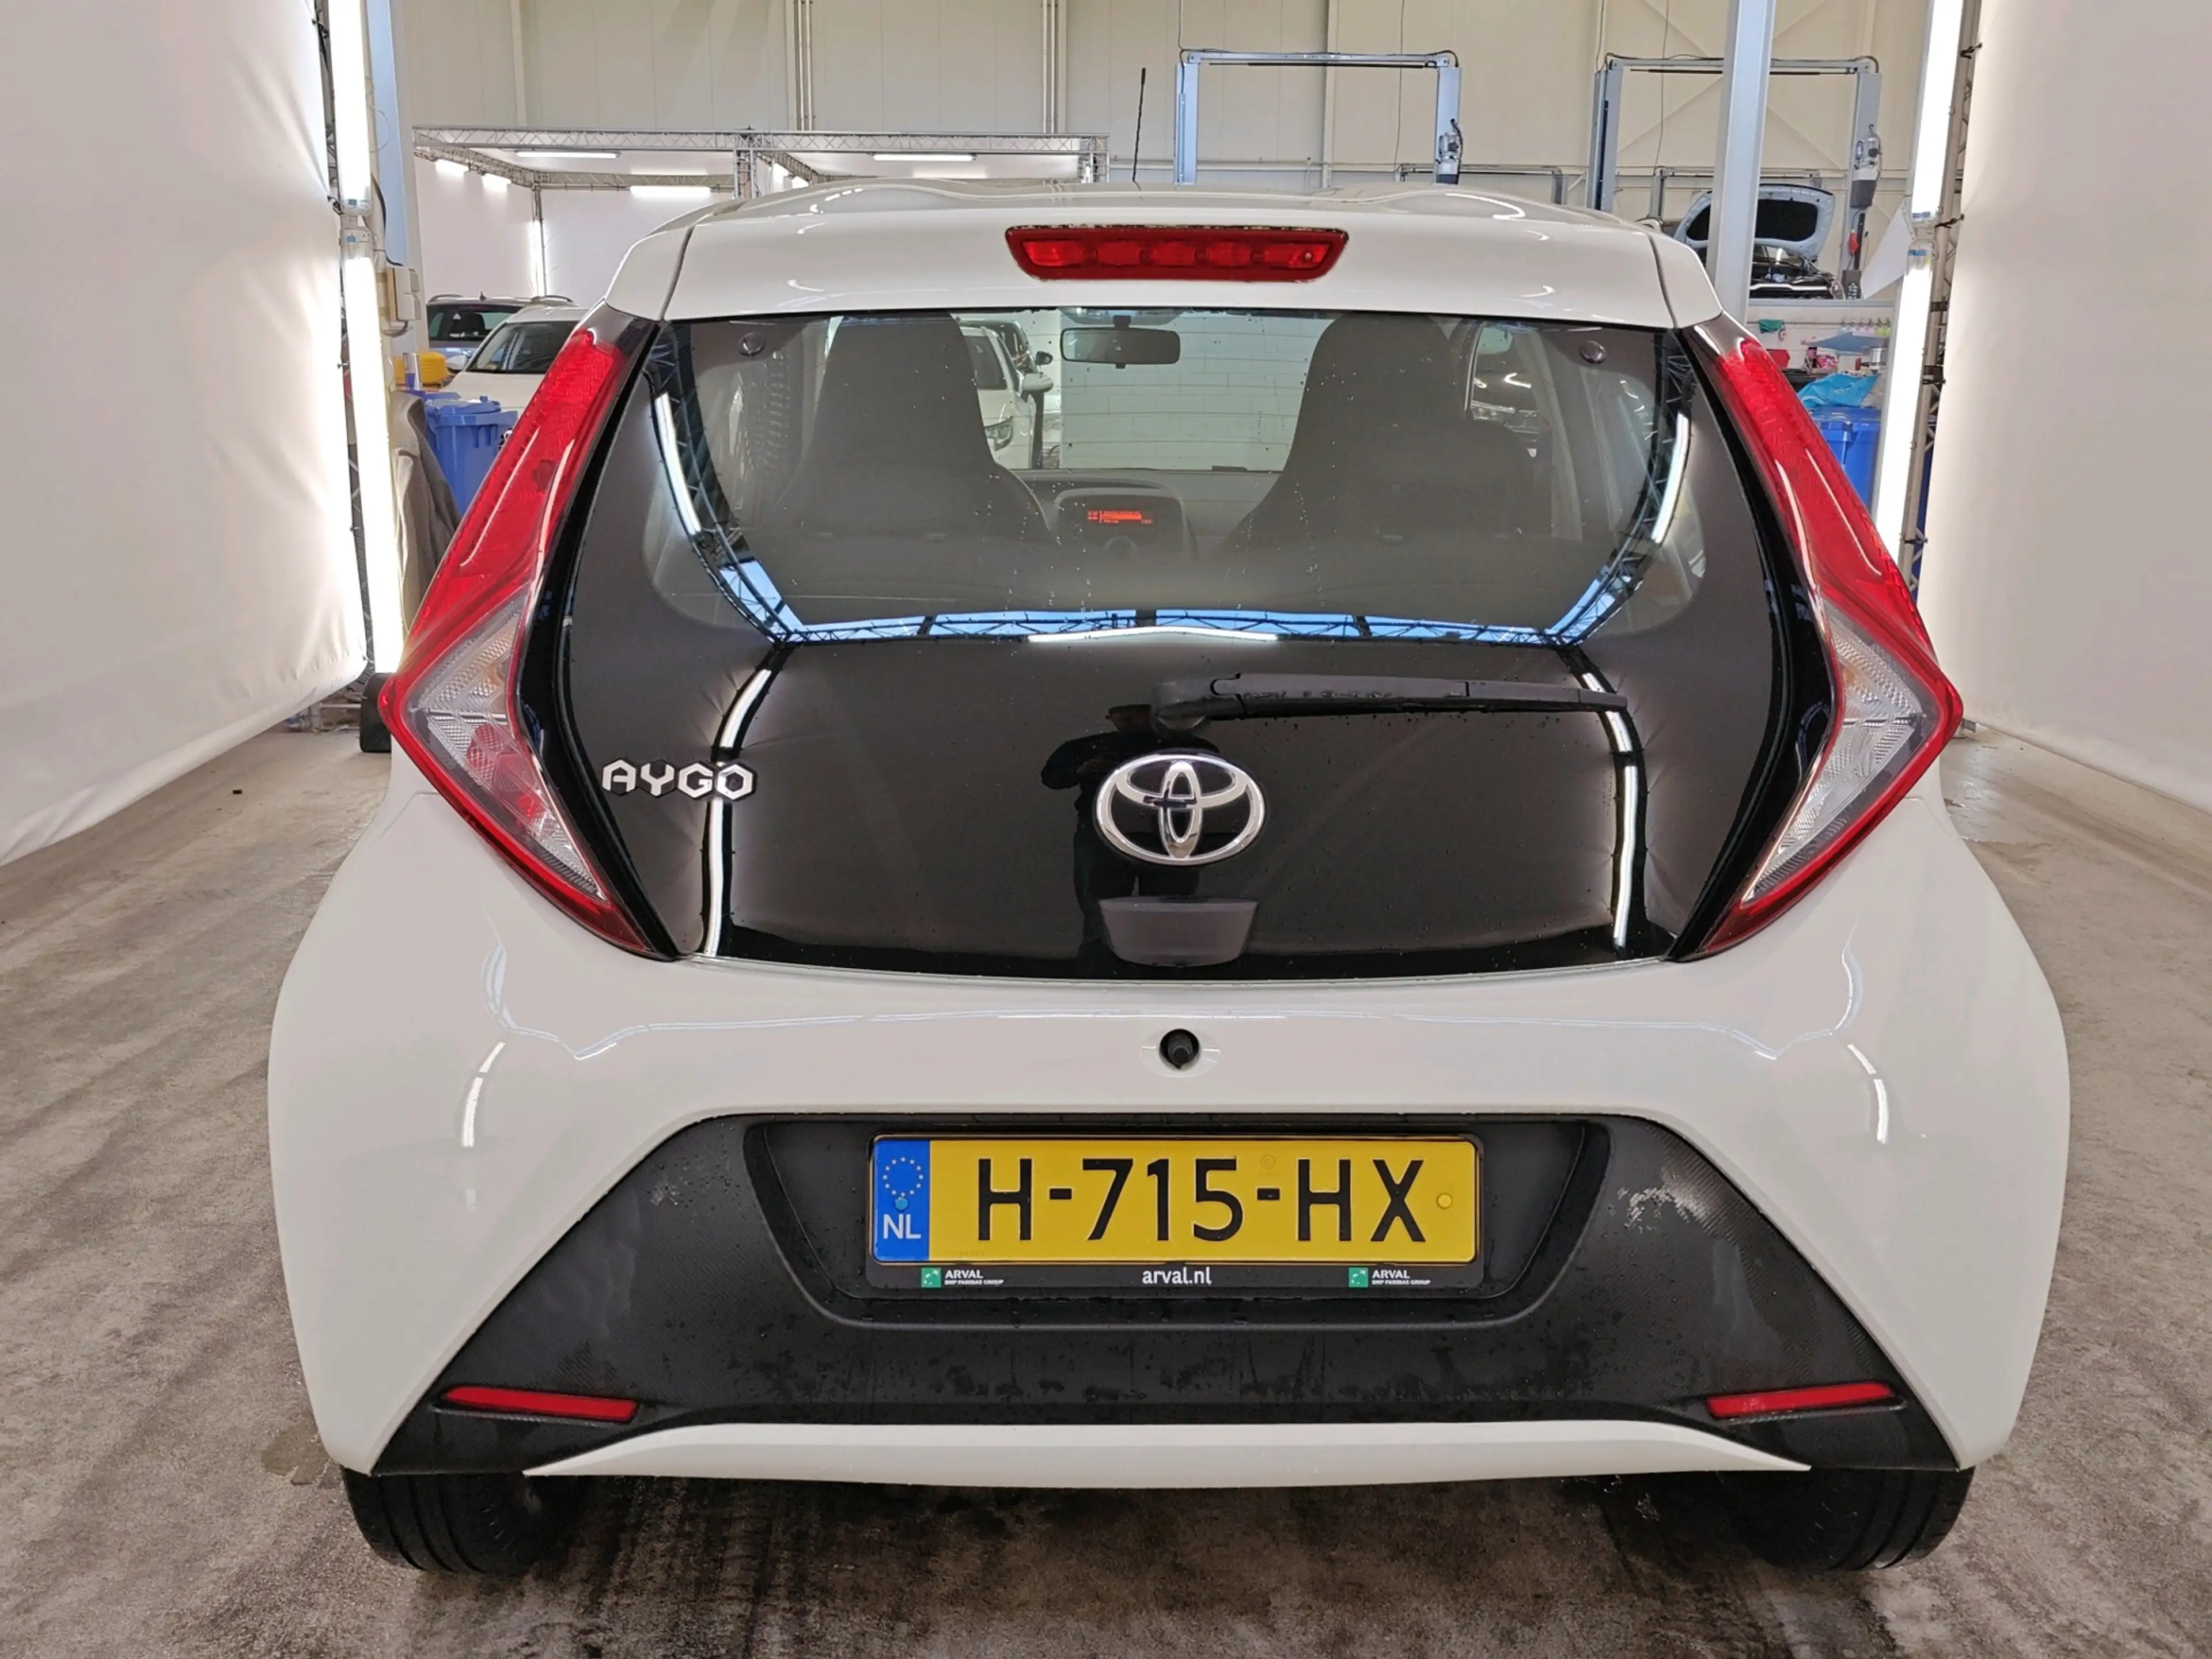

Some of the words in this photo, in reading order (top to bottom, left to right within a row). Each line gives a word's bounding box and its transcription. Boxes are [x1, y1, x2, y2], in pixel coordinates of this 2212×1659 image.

[602, 759, 753, 801] AYGO
[978, 1158, 1427, 1242] H-715-HX
[883, 1214, 921, 1239] NL
[945, 1269, 983, 1279] ARVAL
[1142, 1266, 1212, 1285] arval.nl
[1372, 1269, 1410, 1279] ARVAL
